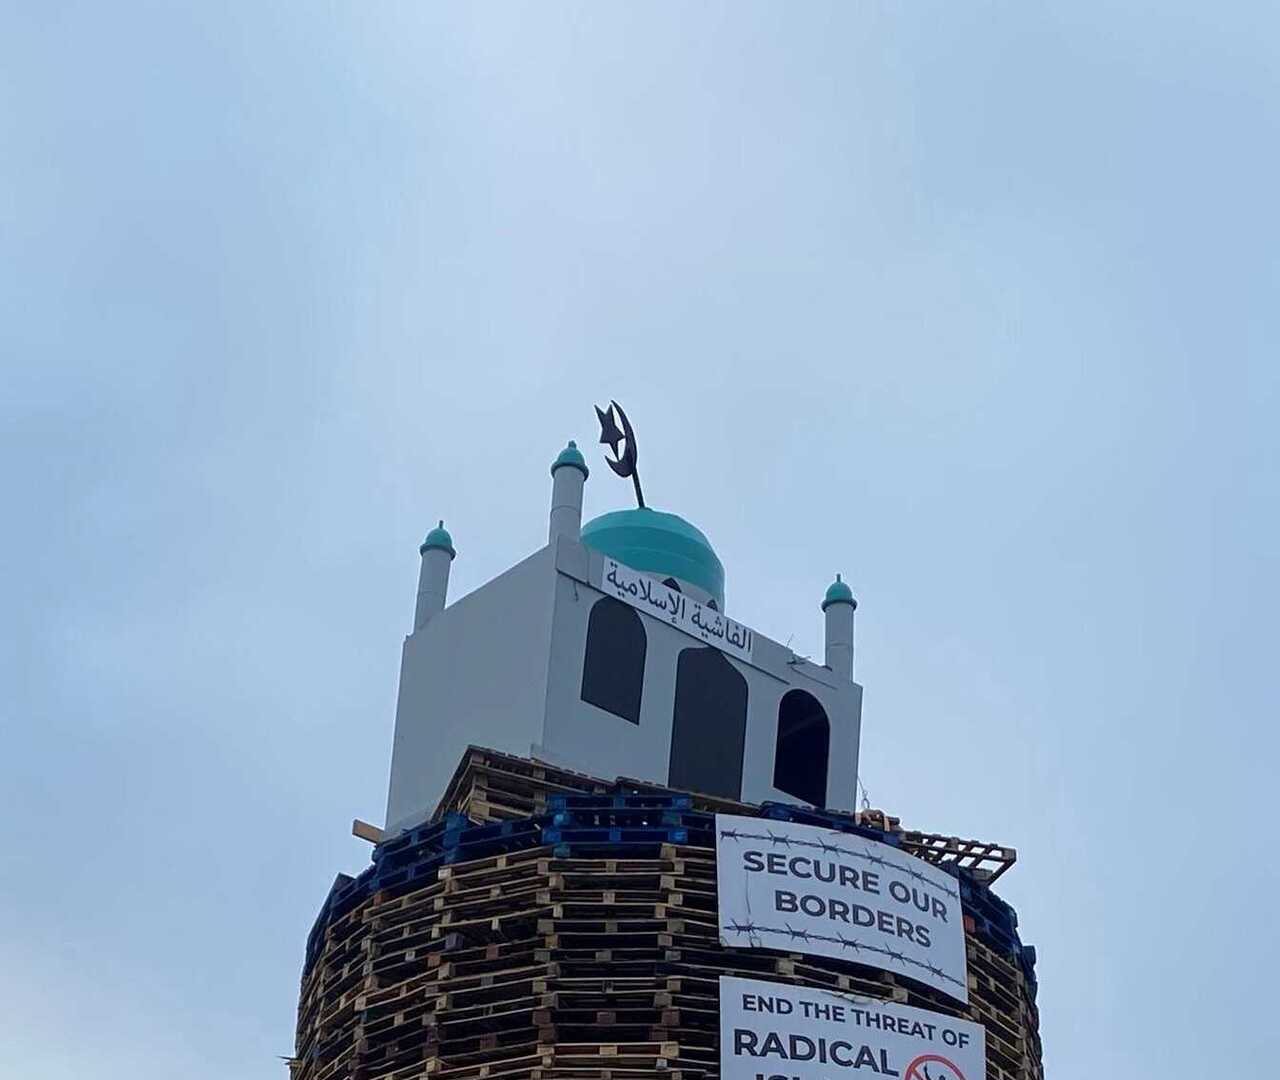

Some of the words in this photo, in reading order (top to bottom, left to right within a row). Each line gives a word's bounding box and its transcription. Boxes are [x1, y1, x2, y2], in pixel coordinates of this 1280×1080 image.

[743, 850, 880, 894] SECURE
[889, 880, 948, 923] OUR
[774, 890, 931, 948] BORDERS
[742, 994, 793, 1014] END
[799, 1001, 845, 1022] THE
[851, 1008, 936, 1041] THREAT
[943, 1029, 970, 1049] OF
[733, 1028, 900, 1077] RADICAL
